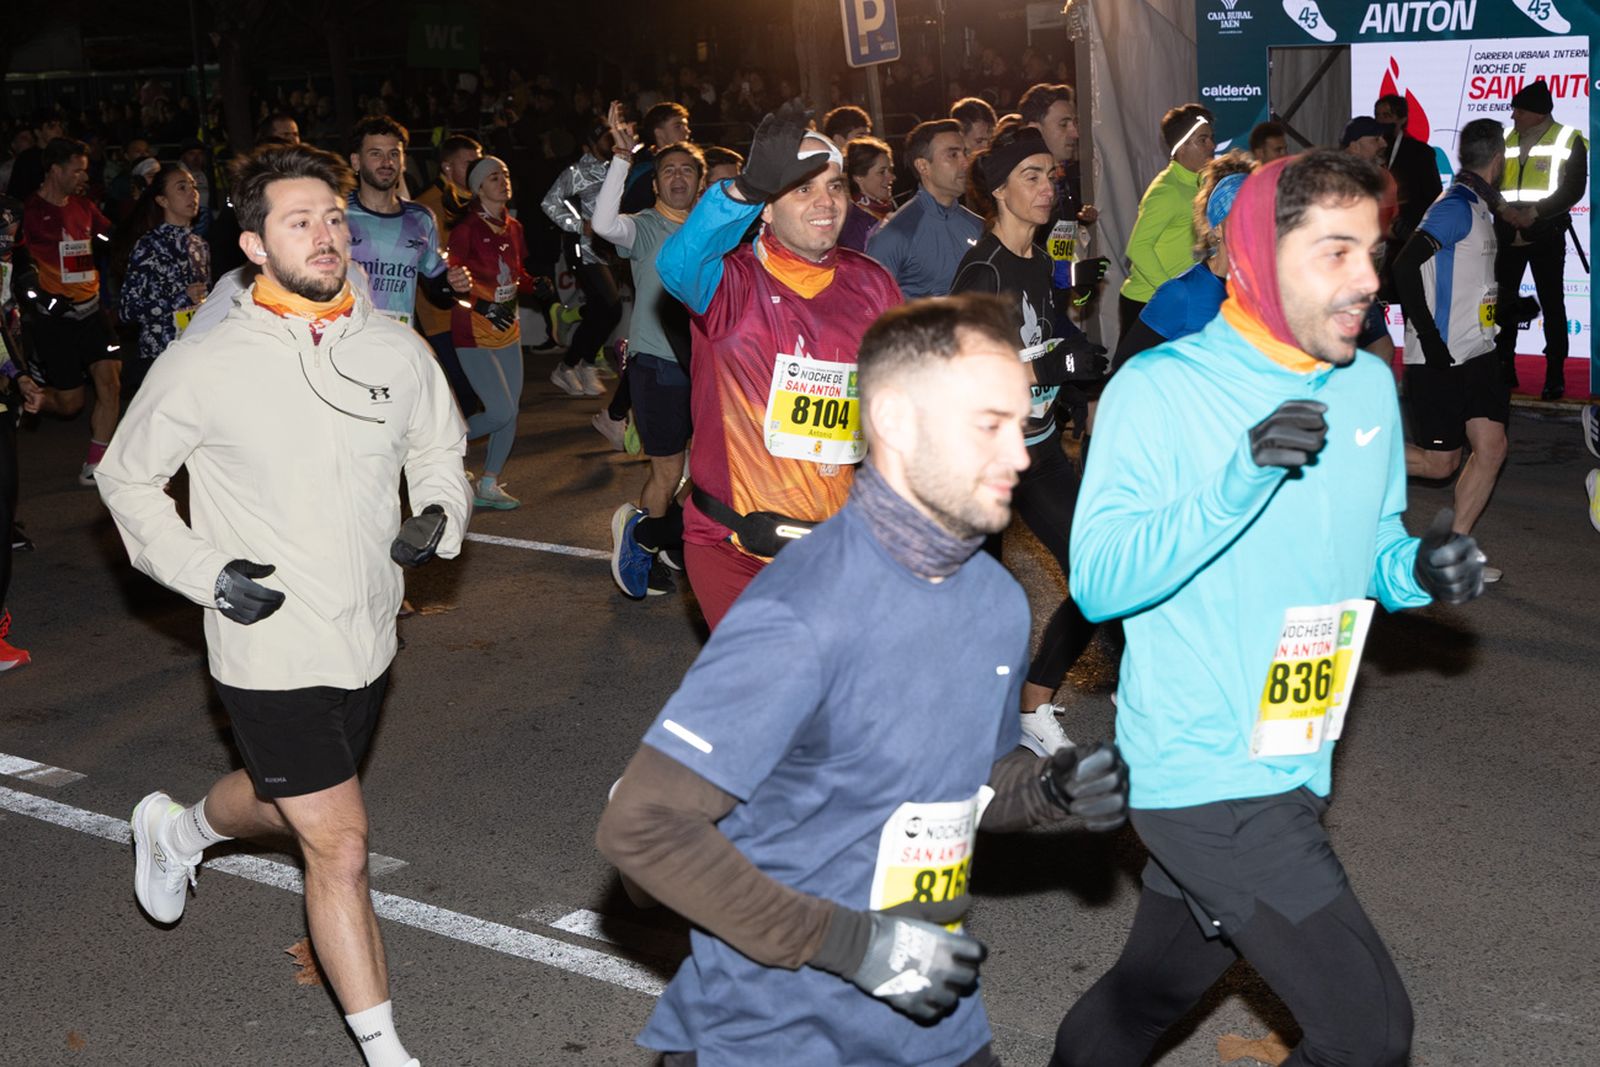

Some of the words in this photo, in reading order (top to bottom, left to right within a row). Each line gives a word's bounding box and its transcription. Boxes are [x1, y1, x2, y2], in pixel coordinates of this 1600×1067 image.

[1227, 11, 1253, 20] RURAL
[1527, 0, 1551, 20] 43
[1299, 7, 1319, 29] 43
[425, 24, 464, 50] WC
[1474, 51, 1513, 61] CARRERA
[1515, 50, 1550, 59] URBANA
[1473, 64, 1510, 74] NOCHE
[1512, 63, 1527, 73] DE
[1468, 75, 1524, 100] SAN
[1476, 103, 1488, 111] DE
[1489, 103, 1514, 111] ENER
[800, 370, 832, 384] NOCHE
[832, 375, 843, 384] DE
[785, 379, 808, 393] SAN
[791, 395, 850, 430] 8104
[1321, 622, 1334, 637] DE
[1268, 659, 1332, 704] 836
[901, 848, 934, 863] SAN
